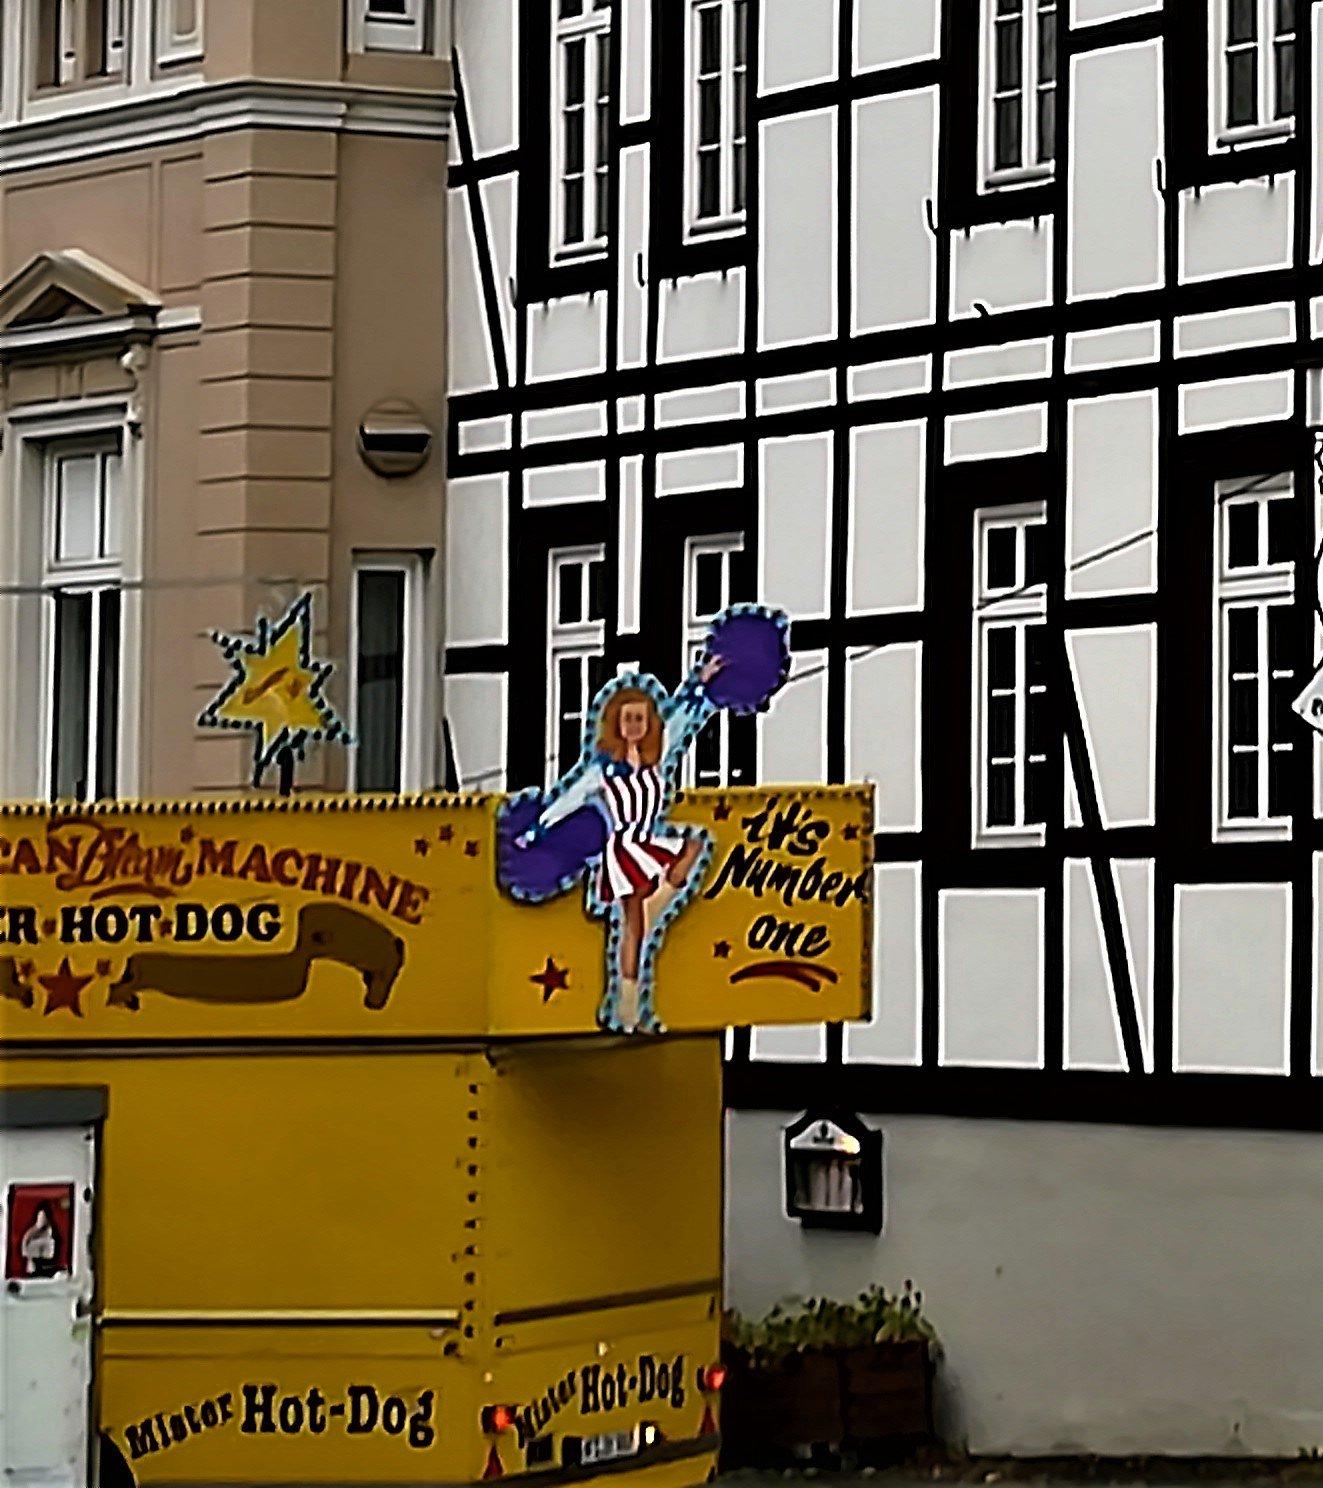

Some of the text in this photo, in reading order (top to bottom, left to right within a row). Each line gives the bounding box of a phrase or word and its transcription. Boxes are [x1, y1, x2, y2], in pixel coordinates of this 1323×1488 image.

[199, 838, 430, 925] MACHINE
[703, 843, 868, 907] Number
[0, 903, 282, 945] R HOT DOG
[747, 914, 831, 958] one
[580, 1354, 685, 1415] Hot-Dog
[124, 1383, 435, 1459] Mister Hot-Dog
